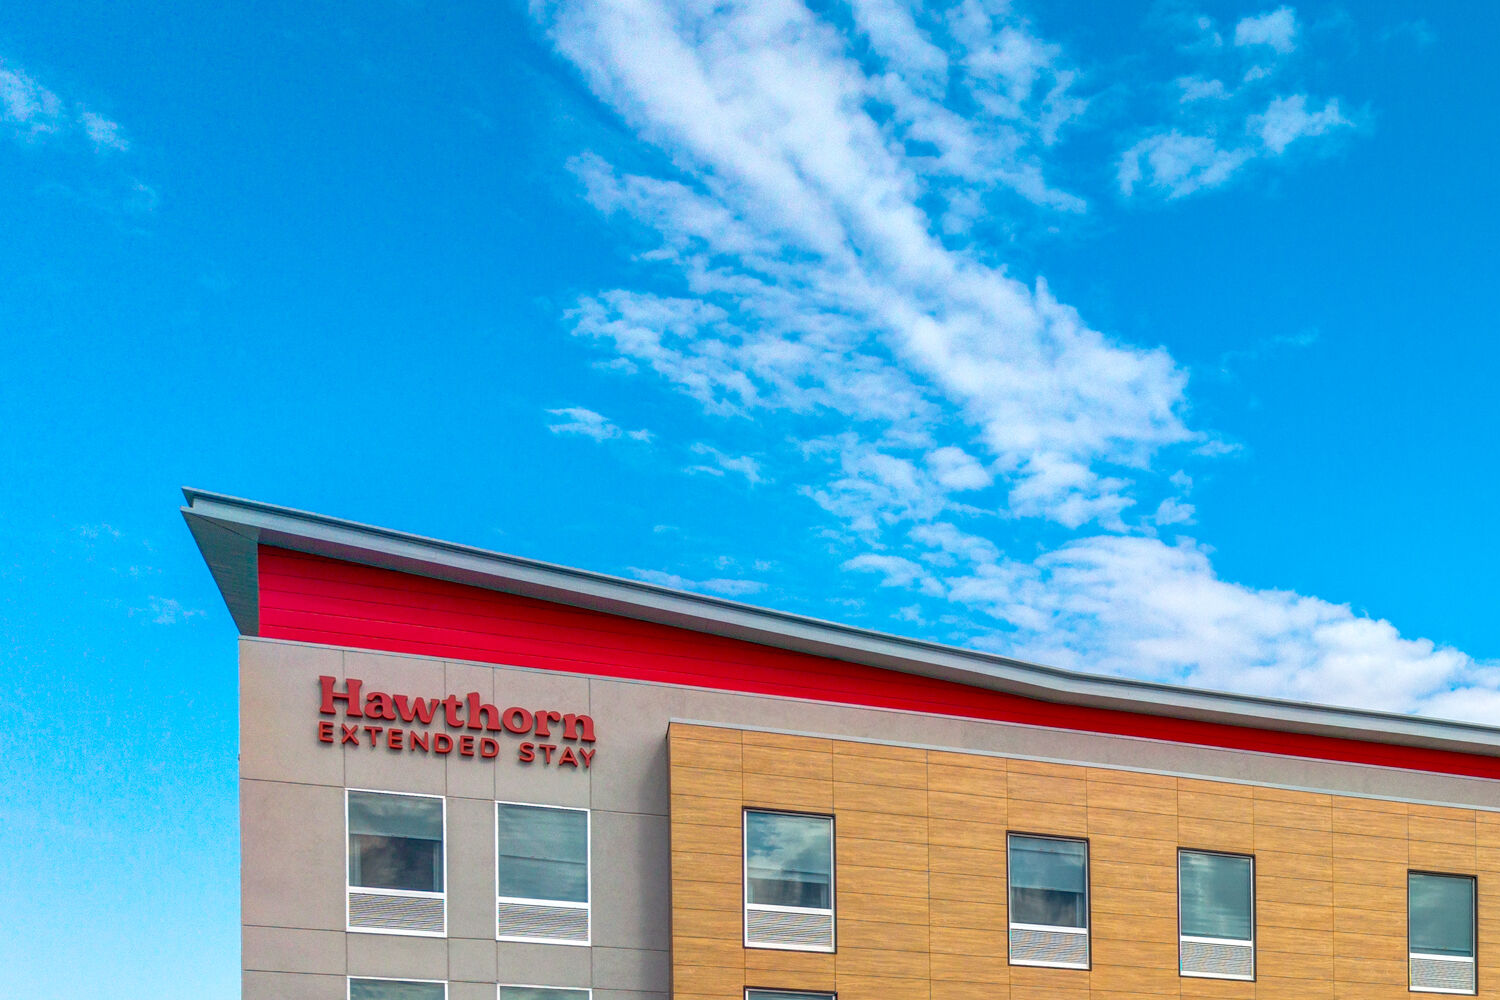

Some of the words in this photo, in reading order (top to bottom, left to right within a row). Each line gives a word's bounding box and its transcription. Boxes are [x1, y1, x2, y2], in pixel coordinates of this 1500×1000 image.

[319, 675, 596, 742] Hawthorn
[318, 721, 500, 758] EXTENDED
[519, 742, 596, 768] STAY
